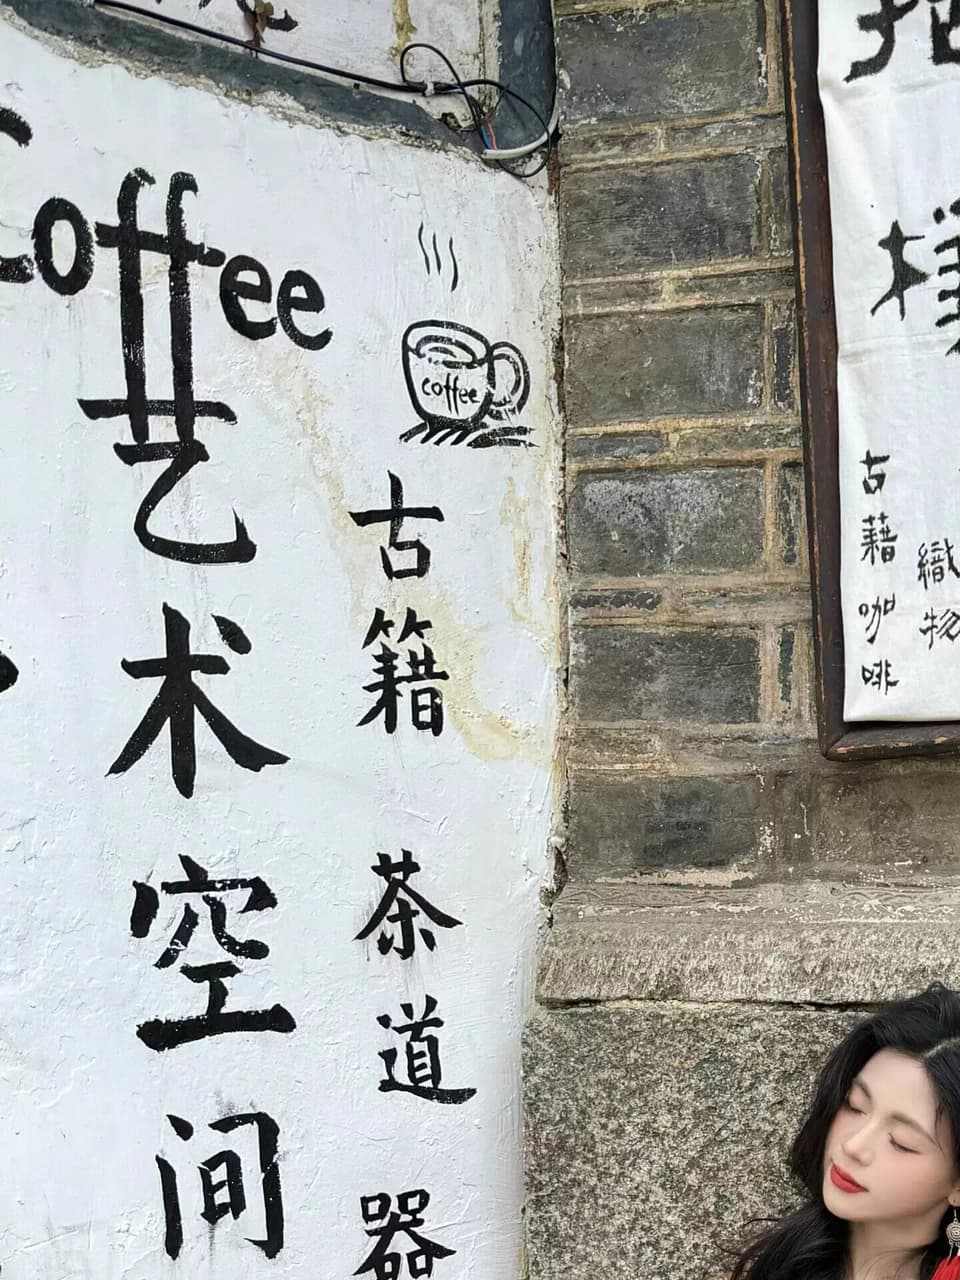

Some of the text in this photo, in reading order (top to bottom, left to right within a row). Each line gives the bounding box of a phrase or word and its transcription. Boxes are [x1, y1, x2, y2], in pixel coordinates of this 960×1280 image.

[421, 373, 480, 416] coffee
[348, 470, 449, 737] 古籍
[77, 398, 297, 1260] 艺术空间
[354, 849, 477, 1106] 茶道
